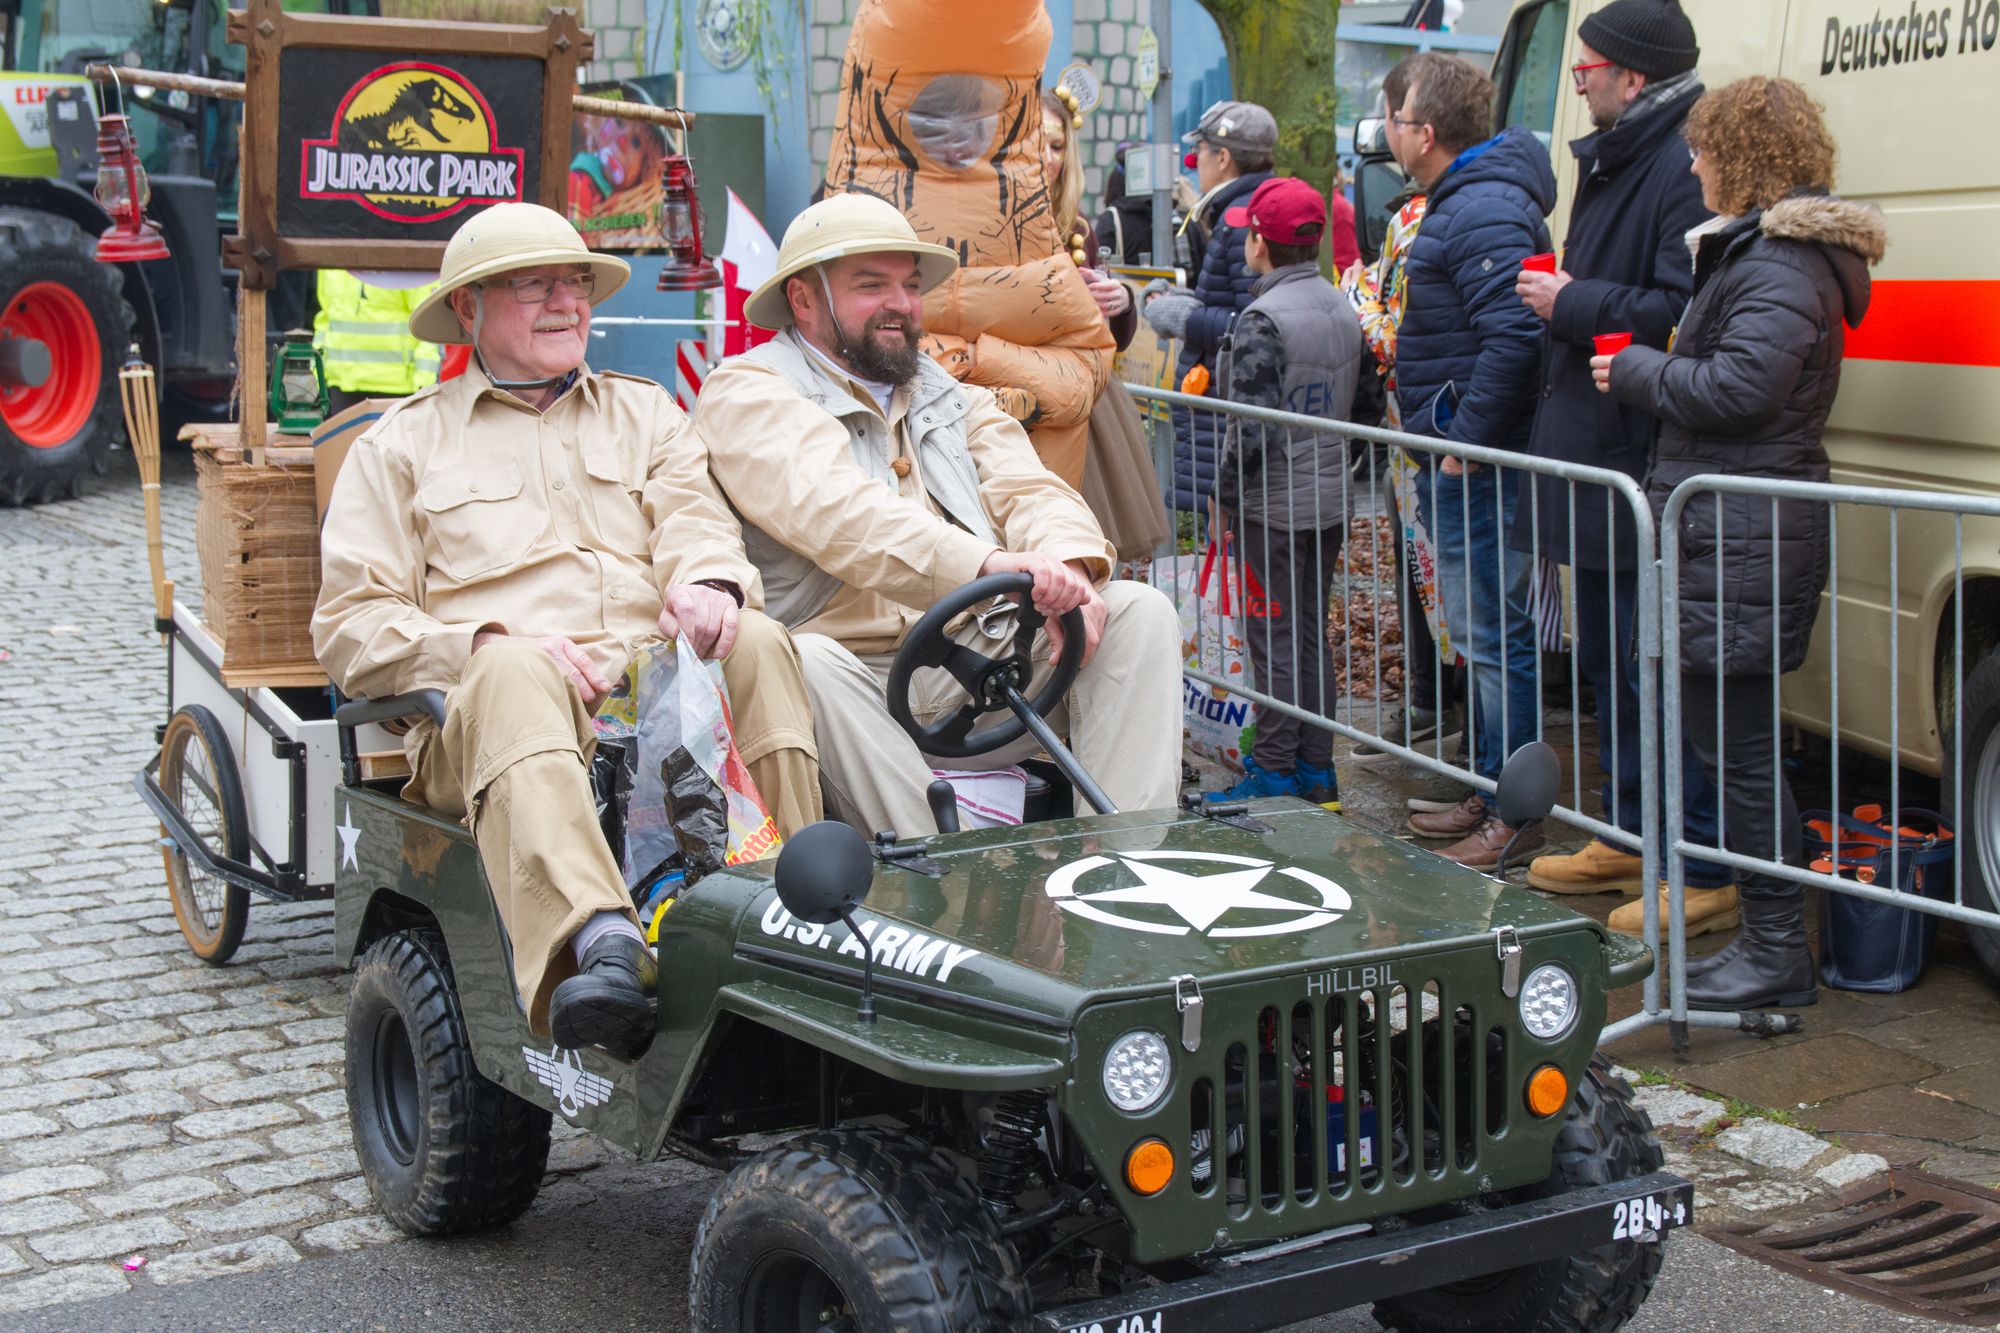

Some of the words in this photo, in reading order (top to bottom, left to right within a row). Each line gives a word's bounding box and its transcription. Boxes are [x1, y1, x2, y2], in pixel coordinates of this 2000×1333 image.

[1820, 1, 1951, 76] Deutsches
[1958, 0, 1999, 54] Ro
[308, 147, 434, 192] JURASSIC
[438, 153, 516, 197] PARK
[837, 919, 981, 983] ARMY
[1307, 964, 1400, 997] HILLBIL
